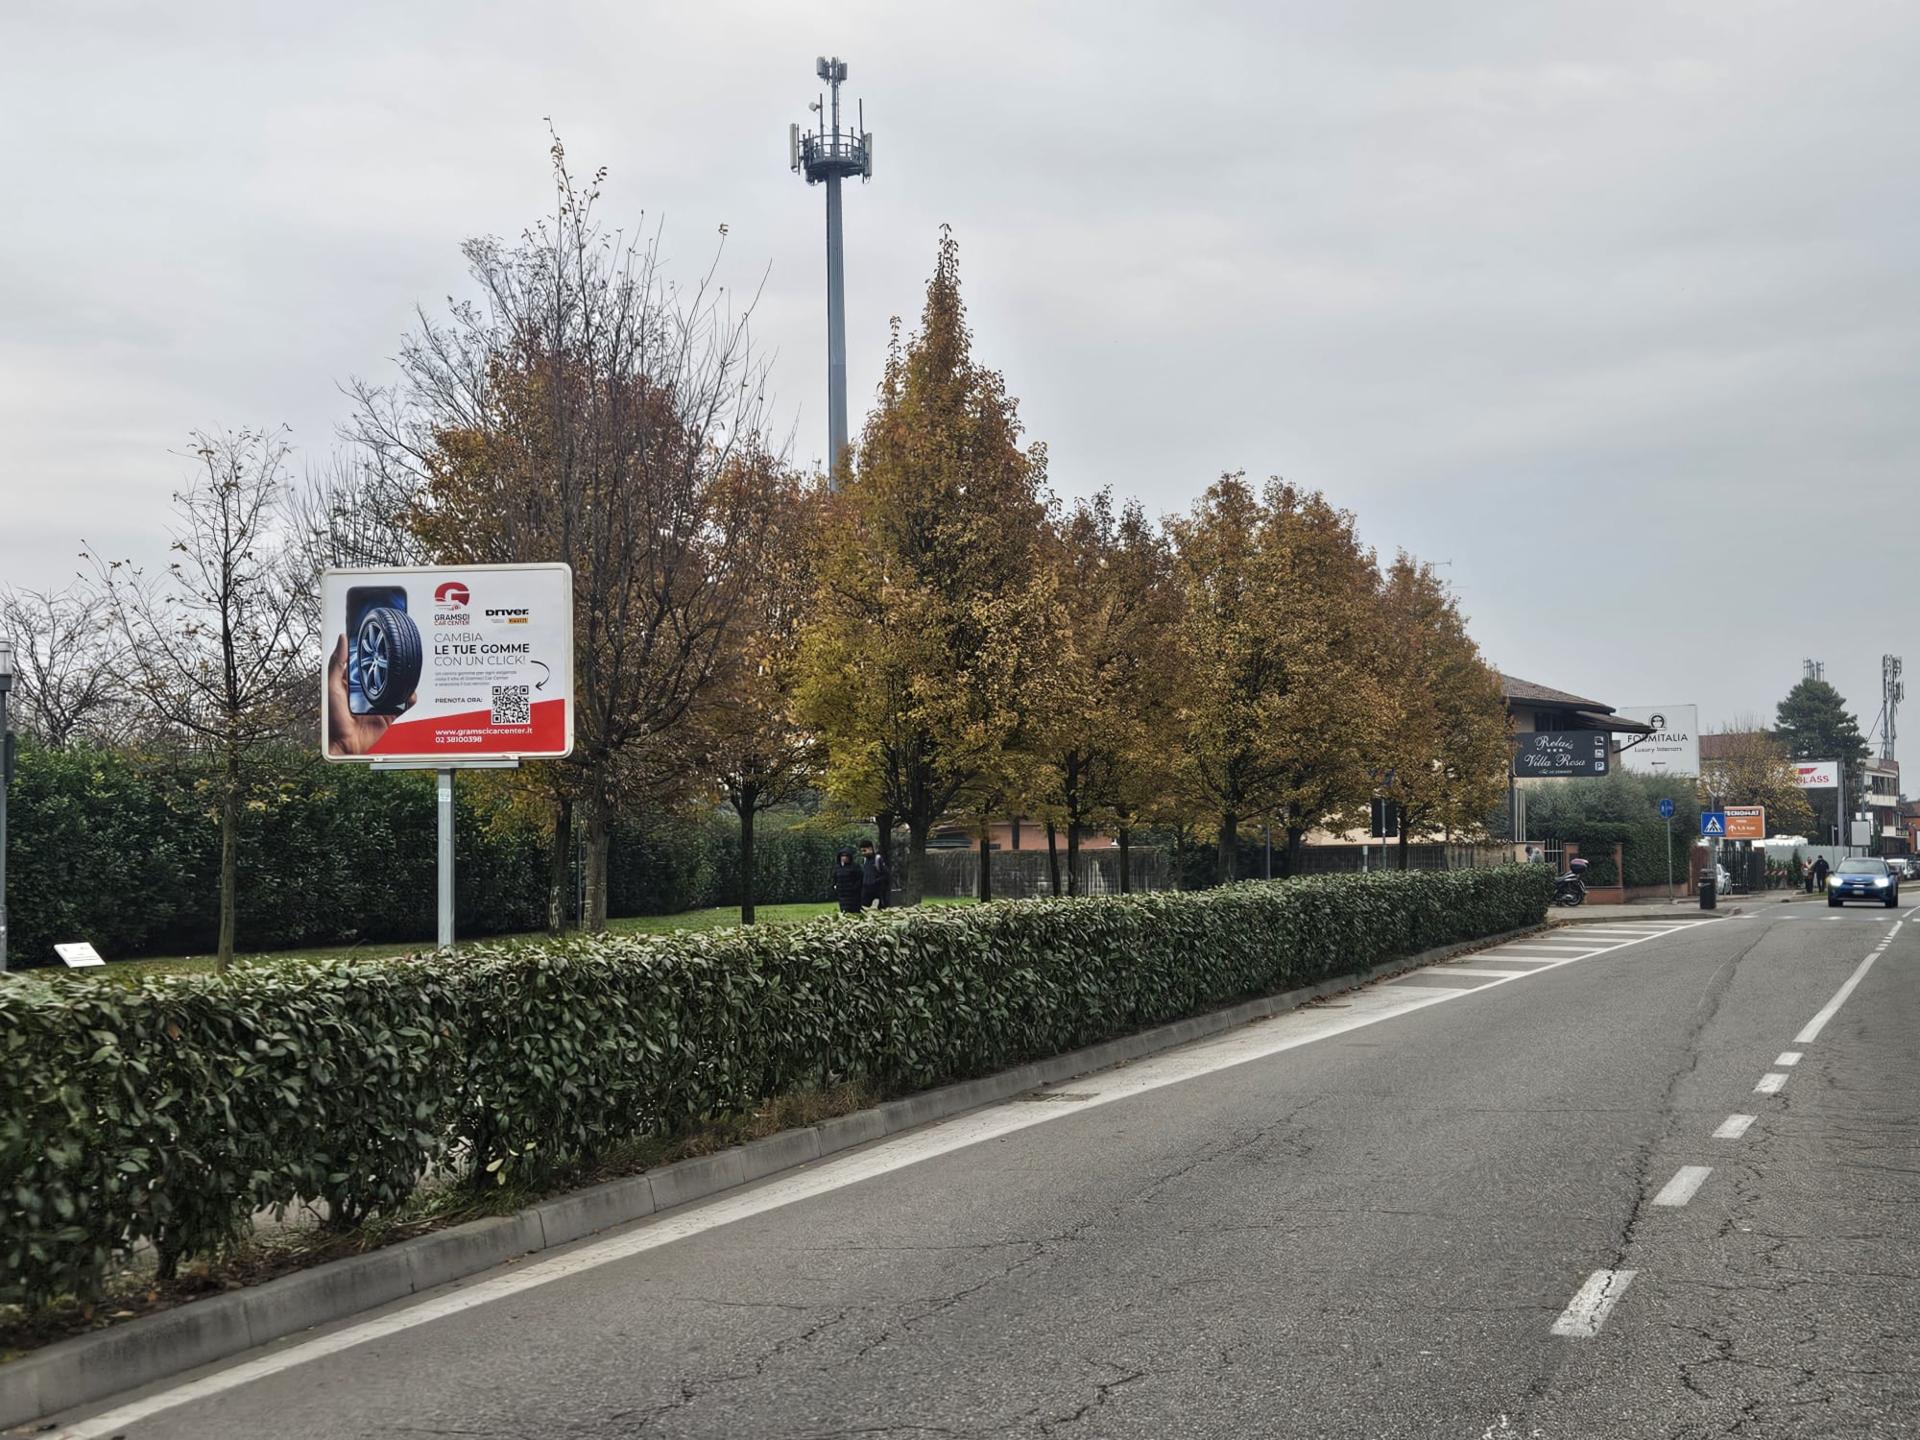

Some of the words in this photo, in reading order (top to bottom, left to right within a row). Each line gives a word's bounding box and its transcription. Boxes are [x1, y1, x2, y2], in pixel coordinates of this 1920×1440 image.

[434, 613, 470, 621] GRAMSCI
[434, 632, 483, 643] CAMBIA
[434, 645, 449, 655] LE
[452, 644, 477, 654] TUE
[480, 643, 530, 654] GOMME
[434, 656, 462, 666] CON
[465, 656, 484, 665] UN
[487, 655, 526, 665] CLICK!
[435, 727, 533, 736] www.gramscicarcenter.it
[1534, 735, 1574, 751] Relais
[1523, 753, 1552, 767] Villa
[1555, 753, 1586, 767] Rosa
